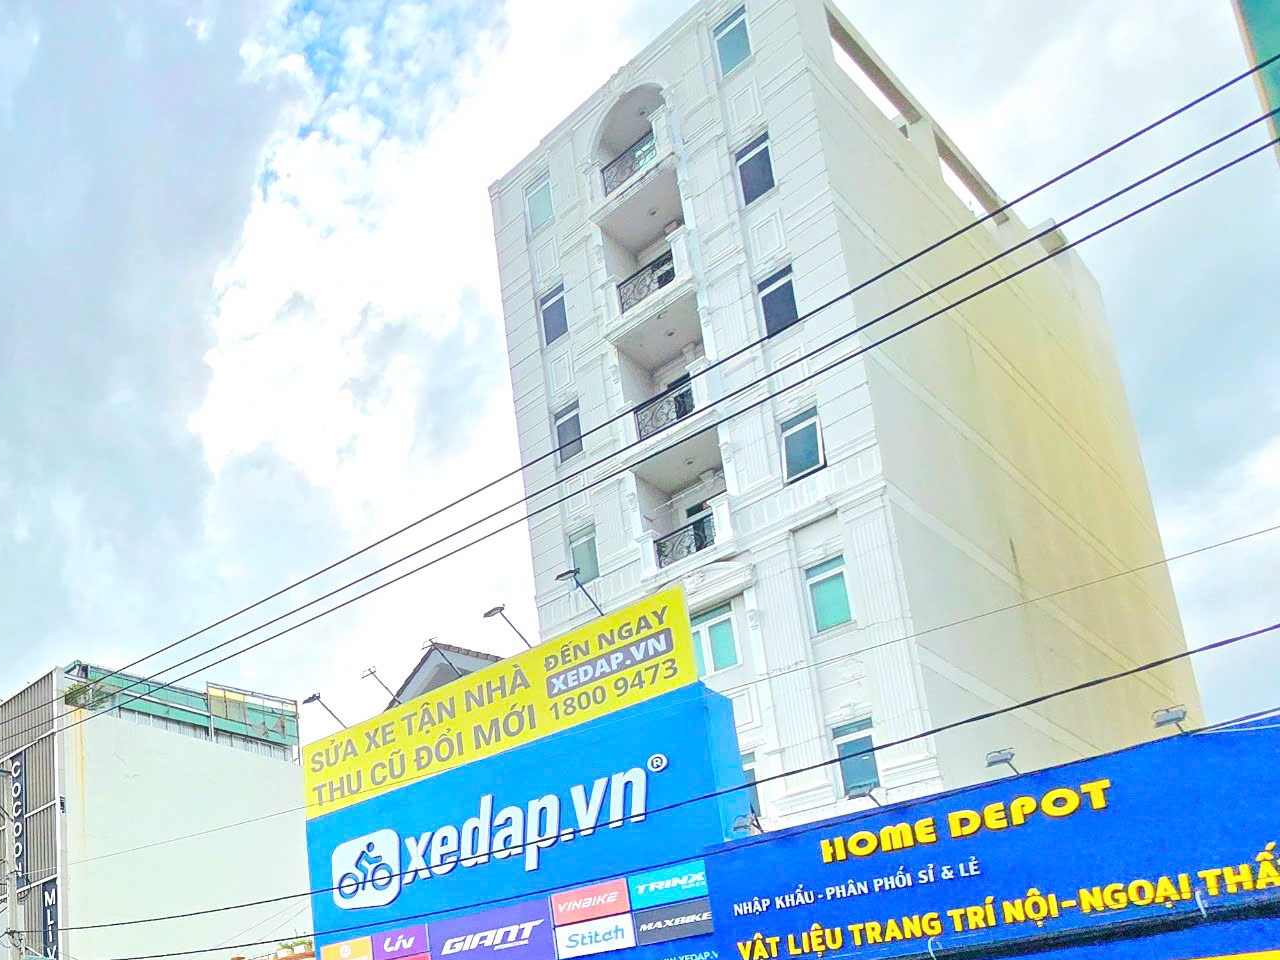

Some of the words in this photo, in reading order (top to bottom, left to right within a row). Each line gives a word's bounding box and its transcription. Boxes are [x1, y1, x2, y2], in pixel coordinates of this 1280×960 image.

[544, 640, 590, 672] ĐẾN
[597, 605, 668, 650] NGAY
[550, 633, 667, 695] XEDAP.VN
[310, 739, 358, 773] SỬA
[364, 721, 397, 753] XE
[401, 696, 456, 736] TẬN
[464, 664, 531, 713] NHÀ
[549, 685, 607, 721] 1800
[614, 657, 678, 698] 9473
[312, 770, 362, 807] THU
[370, 748, 406, 786] CŨ
[413, 727, 464, 771] ĐỔI
[472, 703, 537, 750] MỚI
[821, 816, 938, 865] HOME
[948, 778, 1111, 838] DEPOT
[558, 891, 621, 913] VINBIKE
[637, 871, 706, 895] TRINX
[733, 896, 771, 916] NHẬP
[826, 879, 869, 900] PHÂN
[874, 865, 912, 893] PHỐI
[918, 864, 936, 883] SỈ
[941, 866, 954, 880] &
[958, 856, 981, 877] LẺ
[787, 923, 843, 957] LIỆU
[848, 911, 942, 946] TRANG
[947, 895, 997, 932] TRÍ
[1197, 841, 1280, 896] THẤ
[441, 919, 545, 955] GIANT
[565, 924, 625, 949] Stitch
[639, 911, 713, 932] MAXBIKE
